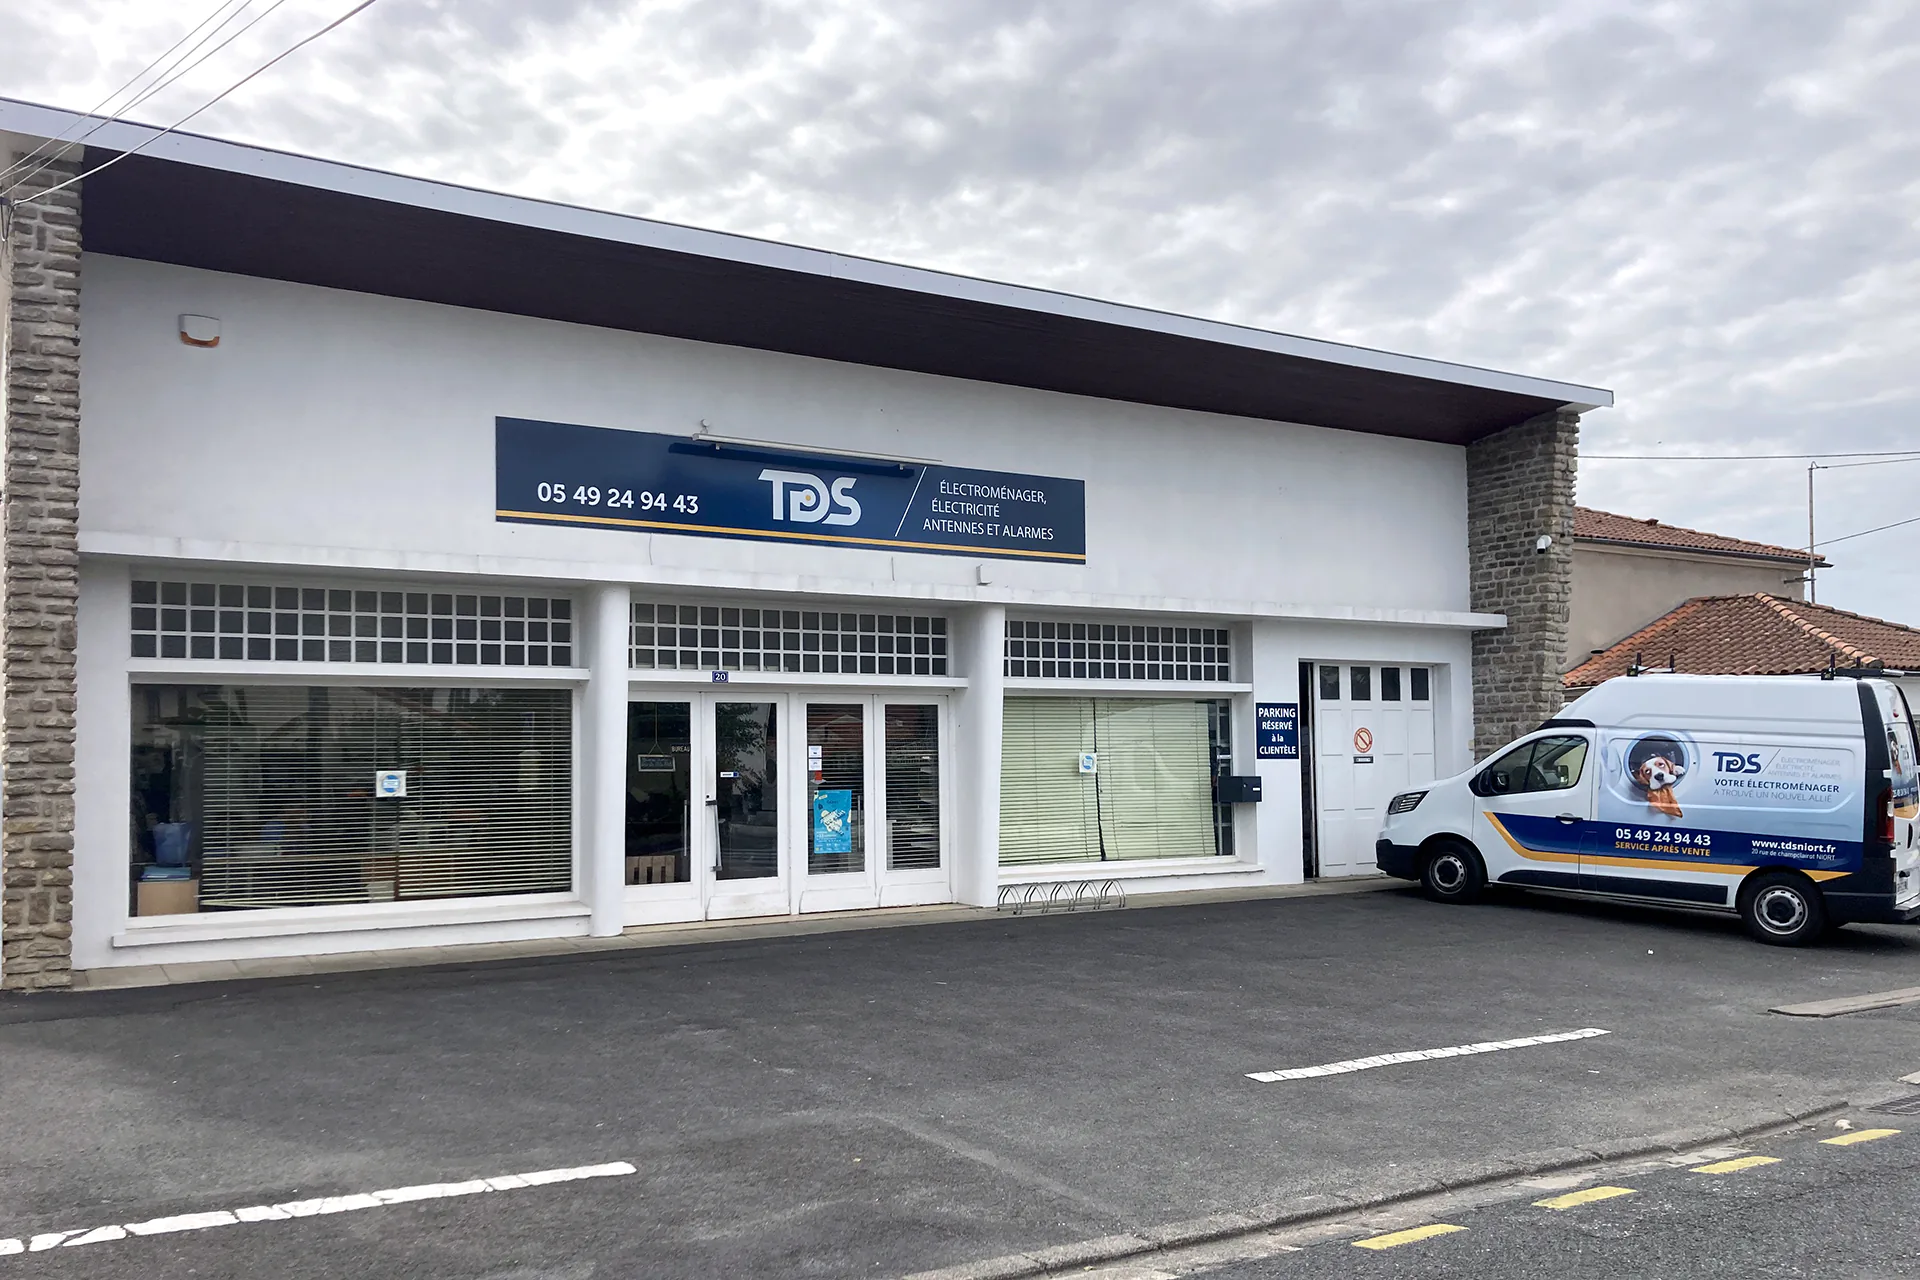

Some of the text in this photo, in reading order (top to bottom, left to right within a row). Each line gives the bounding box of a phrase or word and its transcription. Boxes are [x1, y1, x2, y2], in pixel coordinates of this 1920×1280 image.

[537, 482, 699, 514] 05 49 24 94 43
[758, 468, 862, 526] TDS
[940, 479, 1047, 505] ÉLECTROMÉNAGER,
[931, 498, 1000, 517] ÉLECTRICITÉ
[923, 518, 1054, 540] ANTENNES ET ALARMES
[715, 673, 726, 681] 20
[1258, 707, 1296, 718] PARKING
[1262, 720, 1293, 730] RÉSERVÉ
[1271, 733, 1284, 742] à la
[1259, 744, 1296, 755] CLIENTÈLE
[1712, 751, 1762, 774] TDS
[1714, 779, 1840, 793] VOTRE ÉLECTROMÉNAGER
[1721, 788, 1753, 798] TROUVÉ
[1755, 791, 1769, 799] UN
[1771, 792, 1806, 801] NOUVEL
[1808, 794, 1832, 803] ALLIÉ
[1615, 828, 1711, 846] 05 49 24 94 43
[1615, 841, 1711, 857] SERVICE APRÈS VENTE
[1751, 840, 1836, 853] www.tdsniort.fr
[1816, 853, 1836, 861] NIORT
